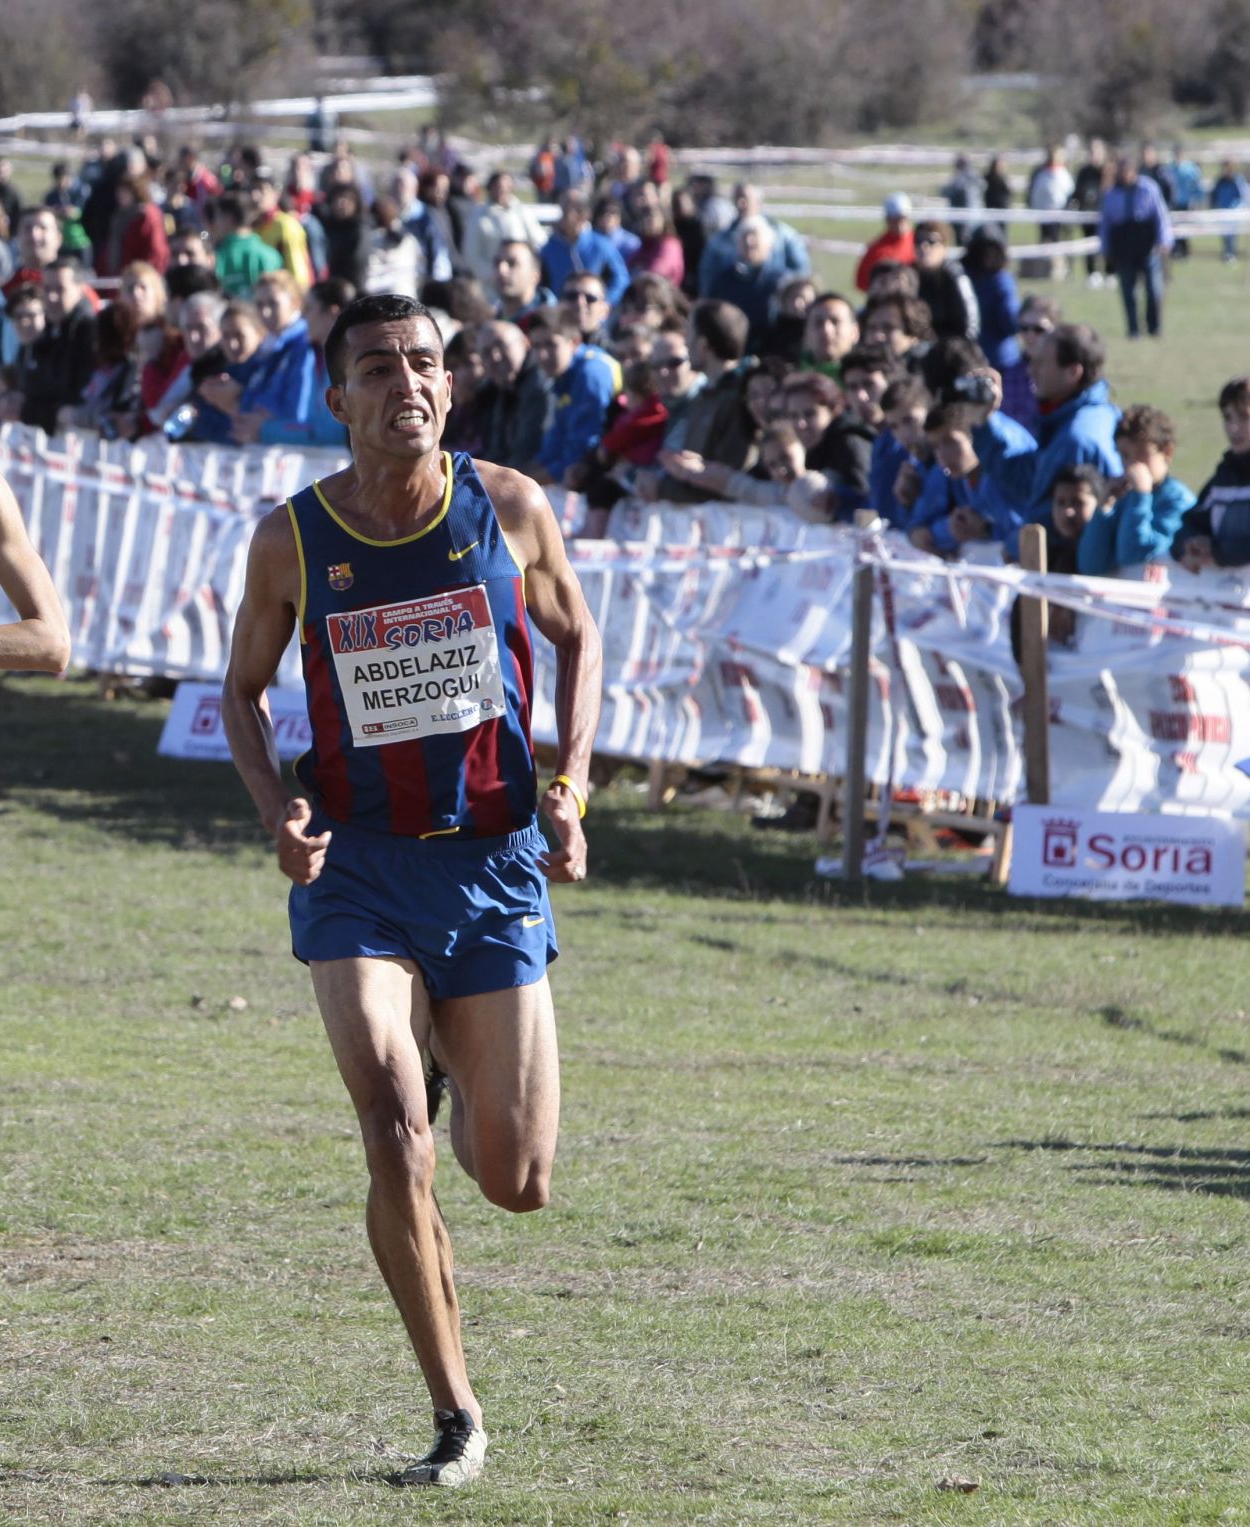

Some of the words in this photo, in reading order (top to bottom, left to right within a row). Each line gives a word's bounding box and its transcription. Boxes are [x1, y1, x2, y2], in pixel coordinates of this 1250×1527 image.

[382, 606, 413, 618] CAMPO
[414, 605, 421, 613] A
[384, 607, 450, 625] INTERNACIONAL
[452, 603, 463, 611] DE
[384, 610, 474, 651] SORIA
[339, 613, 378, 652] XIX
[353, 645, 480, 684] ABDELAZIZ
[362, 674, 480, 711] MERZOGUI
[1088, 834, 1213, 875] Soria
